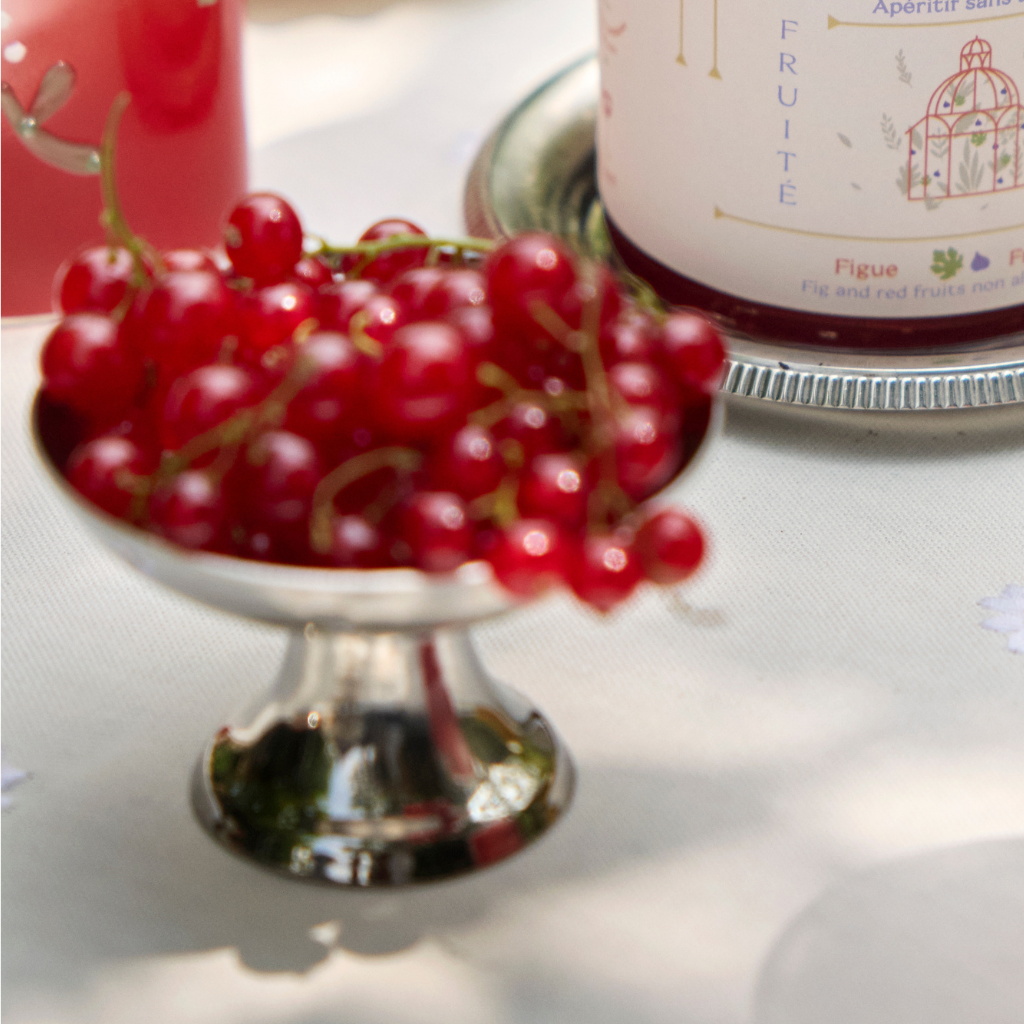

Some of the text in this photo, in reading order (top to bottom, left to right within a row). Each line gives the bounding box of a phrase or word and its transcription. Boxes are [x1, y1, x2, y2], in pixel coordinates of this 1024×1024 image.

[776, 19, 799, 206] FRUITÉ
[835, 257, 899, 281] Figue
[801, 279, 830, 299] Fig
[835, 284, 871, 300] and
[876, 284, 908, 300] red
[914, 283, 966, 299] fruits
[971, 279, 1005, 294] non
